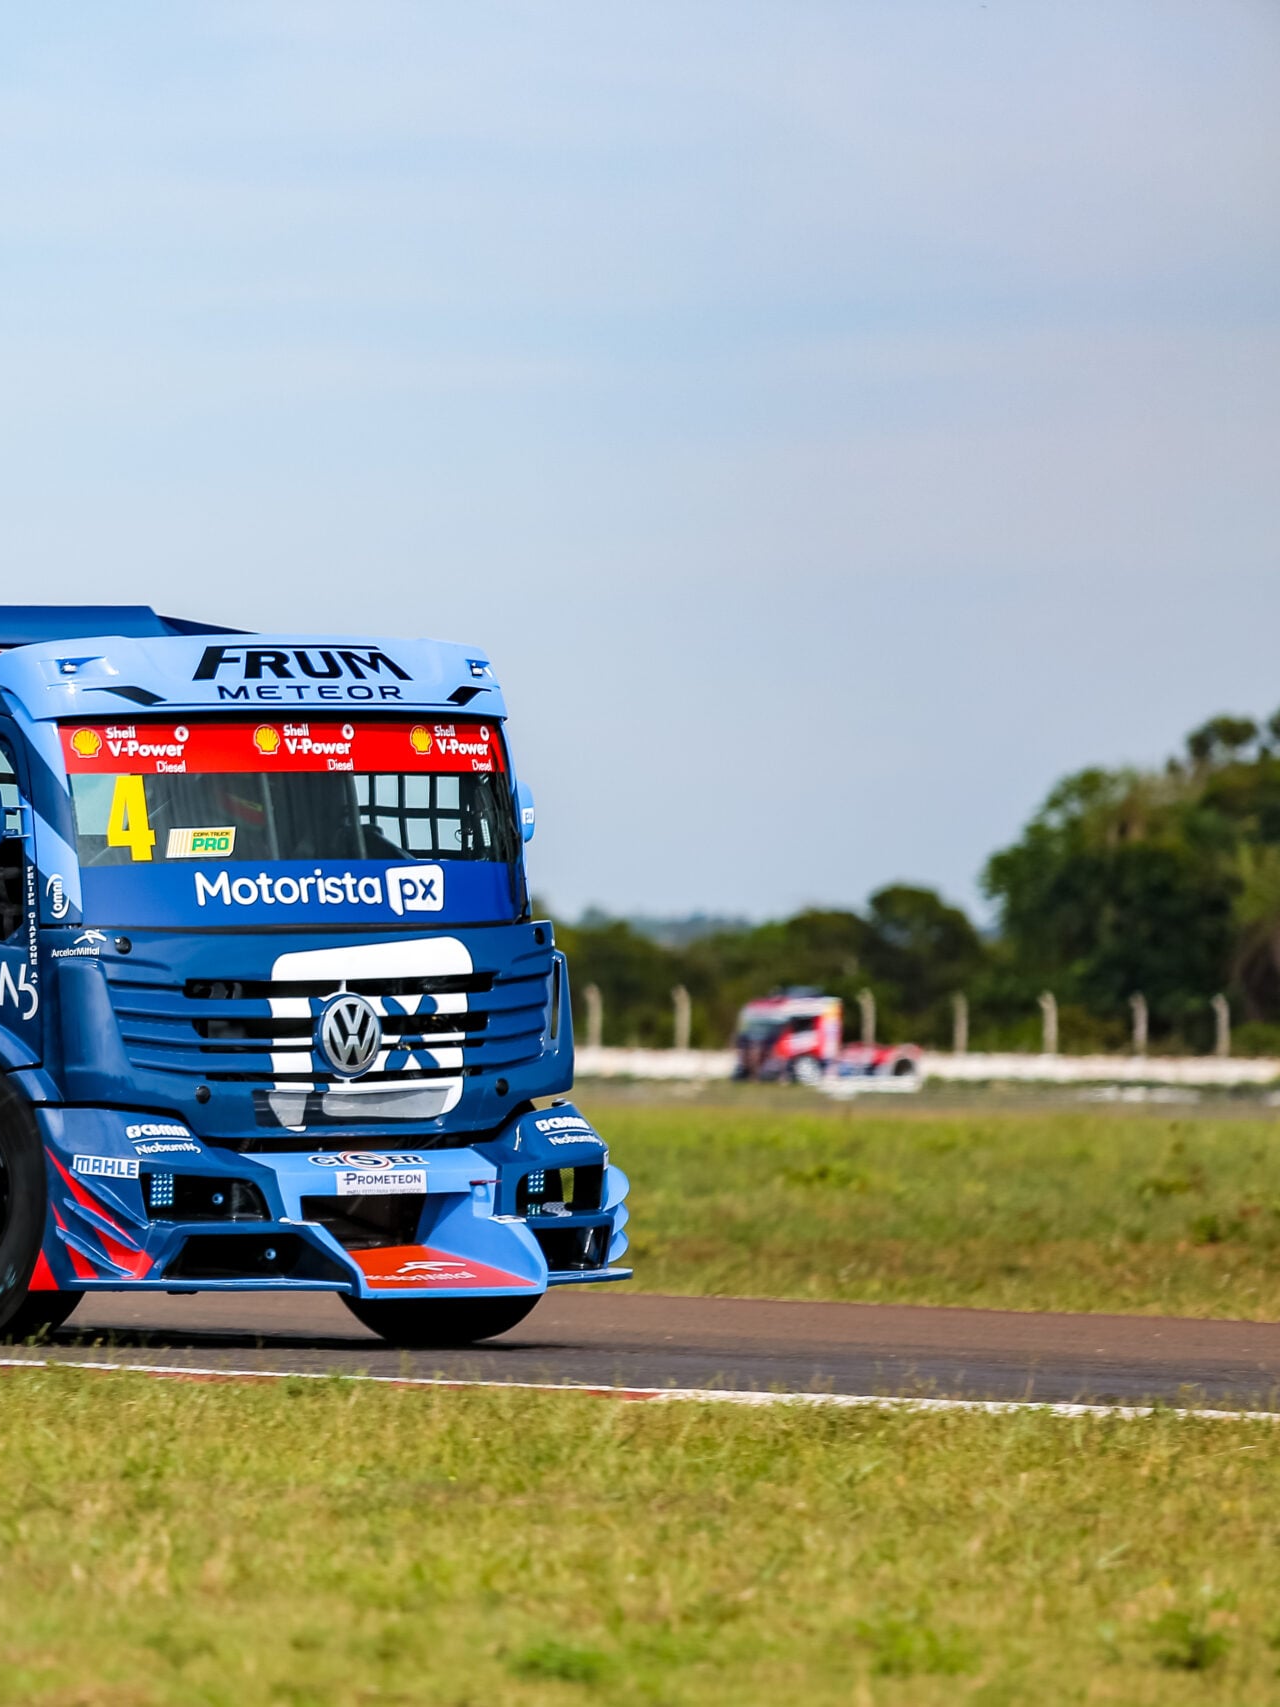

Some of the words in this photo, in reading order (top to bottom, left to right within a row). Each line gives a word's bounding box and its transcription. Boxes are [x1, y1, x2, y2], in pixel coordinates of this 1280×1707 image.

[192, 645, 414, 681] FRUM
[217, 685, 404, 700] METEOR
[106, 727, 135, 739] Shell
[283, 724, 309, 737] Shell
[434, 725, 455, 737] Shell
[108, 740, 184, 757] V-Power
[285, 738, 351, 755] V-Power
[436, 738, 488, 756] V-Power
[156, 760, 186, 773] Diesel
[327, 758, 354, 771] Diesel
[472, 759, 493, 772] Diesel
[107, 775, 156, 861] 4
[192, 838, 229, 851] PRO
[27, 866, 35, 905] FELIPE
[194, 868, 383, 907] Motorista
[399, 878, 437, 912] px
[28, 912, 38, 965] GIAFFONE
[51, 946, 100, 958] ArcelorMittal
[76, 1157, 137, 1176] MAHLE
[311, 1152, 425, 1167] CISER
[343, 1173, 422, 1185] PROMETEON
